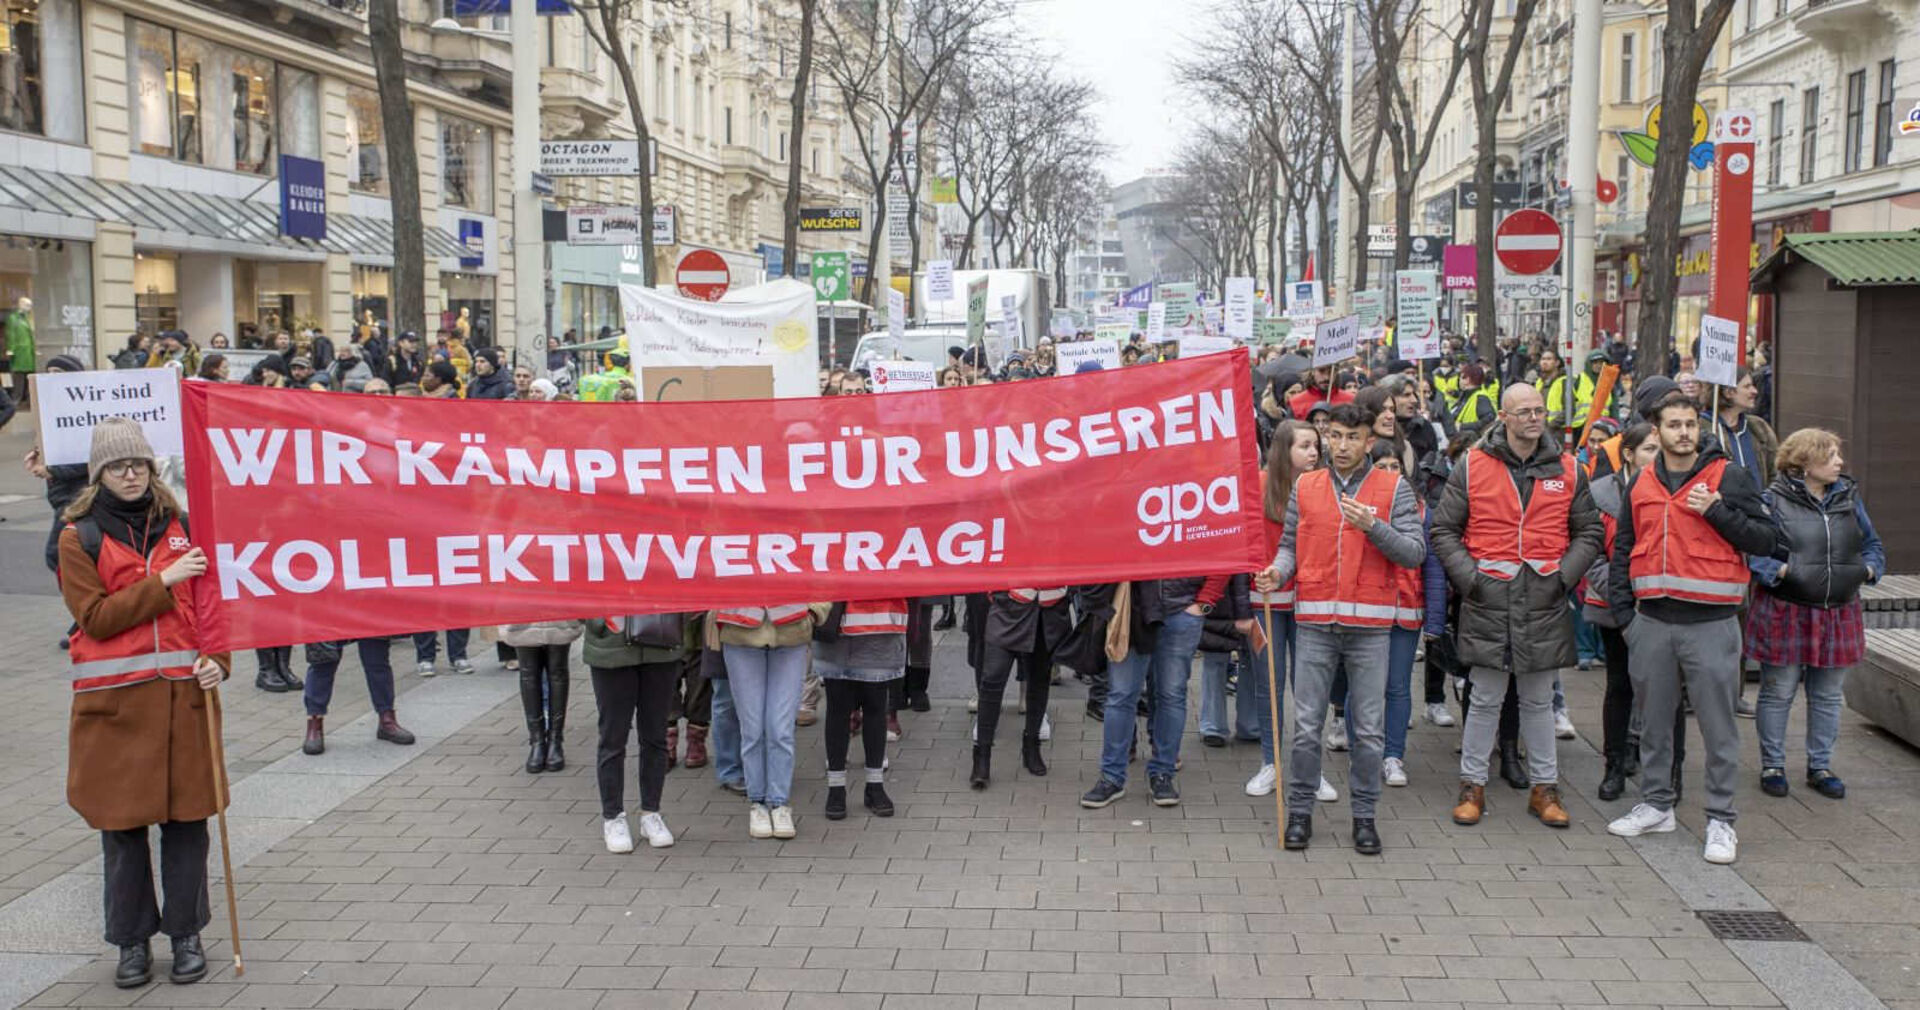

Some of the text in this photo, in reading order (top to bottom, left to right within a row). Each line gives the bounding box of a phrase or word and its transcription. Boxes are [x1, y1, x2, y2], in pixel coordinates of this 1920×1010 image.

[541, 144, 612, 154] OCTAGON
[290, 184, 324, 200] KLEIDER
[290, 198, 324, 214] BAUER
[801, 216, 860, 229] wutscher
[1446, 276, 1475, 287] BIPA
[62, 305, 90, 325] SHOP
[1327, 326, 1349, 340] Mehr
[1060, 346, 1115, 357] Soziale Arbeit
[1317, 339, 1354, 358] Personal
[888, 370, 932, 380] BETRIEBSRAT
[65, 382, 152, 402] Wir sind
[206, 388, 1238, 495] WIR KÄMPFEN FÜR UNSEREN
[1137, 476, 1239, 546] gpa
[1186, 525, 1208, 533] MEINE
[1186, 526, 1242, 541] GEWERKSCHAFT
[214, 517, 1006, 601] KOLLEKTIVVERTRAG!
